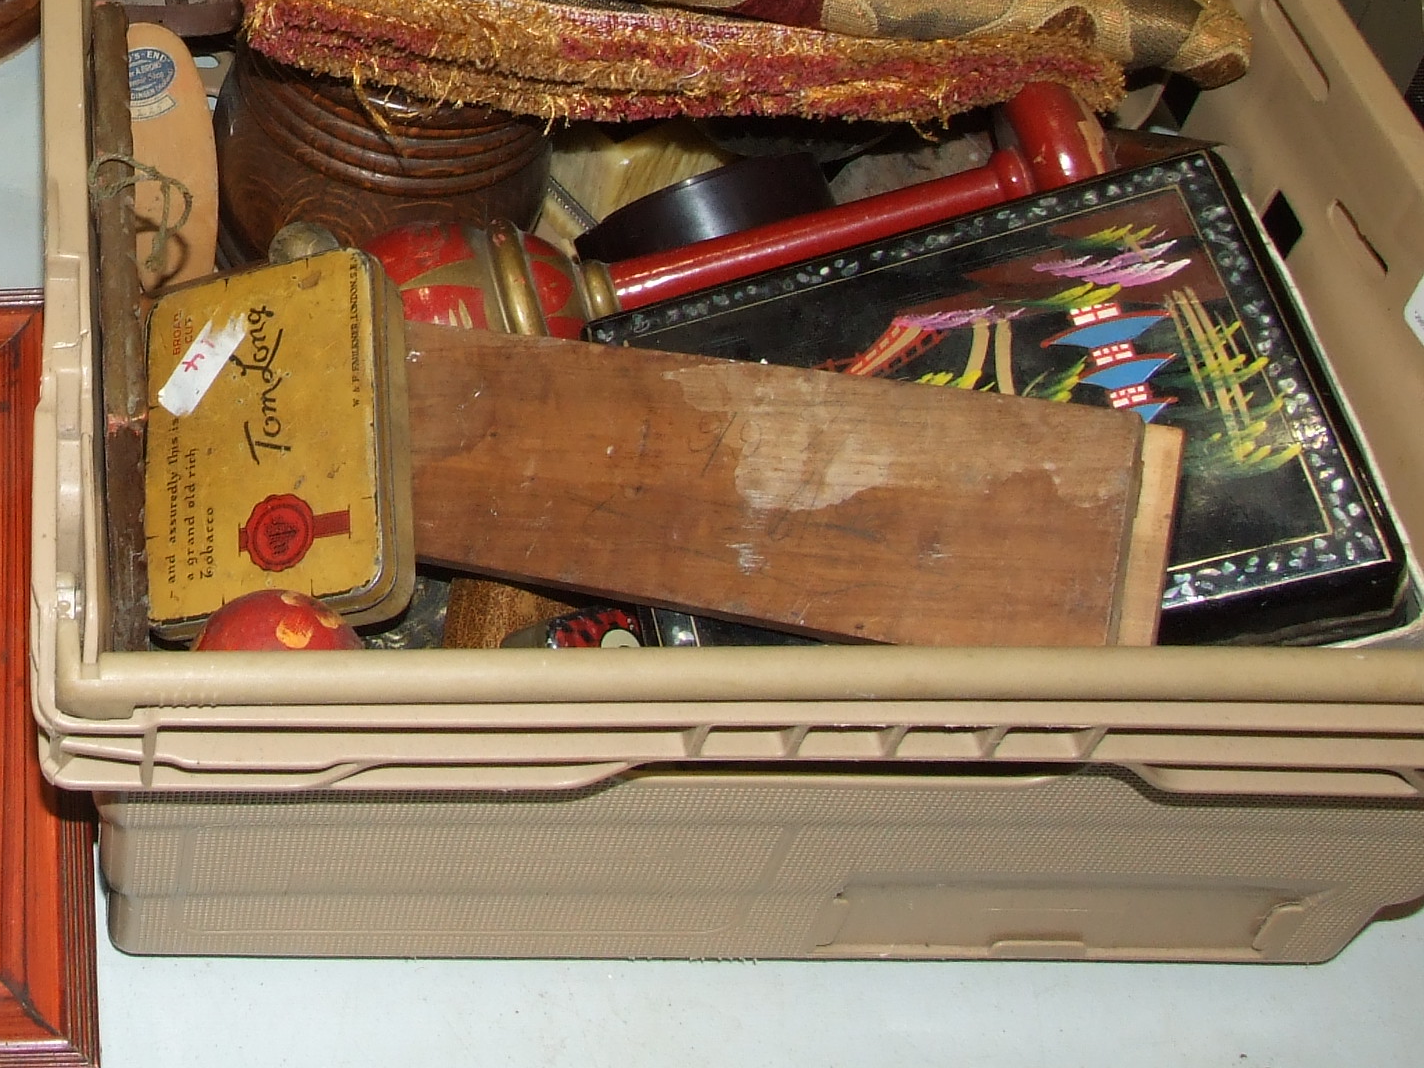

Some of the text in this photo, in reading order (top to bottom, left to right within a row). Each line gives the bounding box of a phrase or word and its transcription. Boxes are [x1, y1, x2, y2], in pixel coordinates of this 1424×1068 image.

[229, 306, 283, 383] Long
[244, 377, 291, 465] Tom
[167, 472, 181, 544] assuredly
[185, 448, 198, 581] a grand old rich
[200, 507, 214, 580] Tobacco
[165, 554, 176, 583] and
